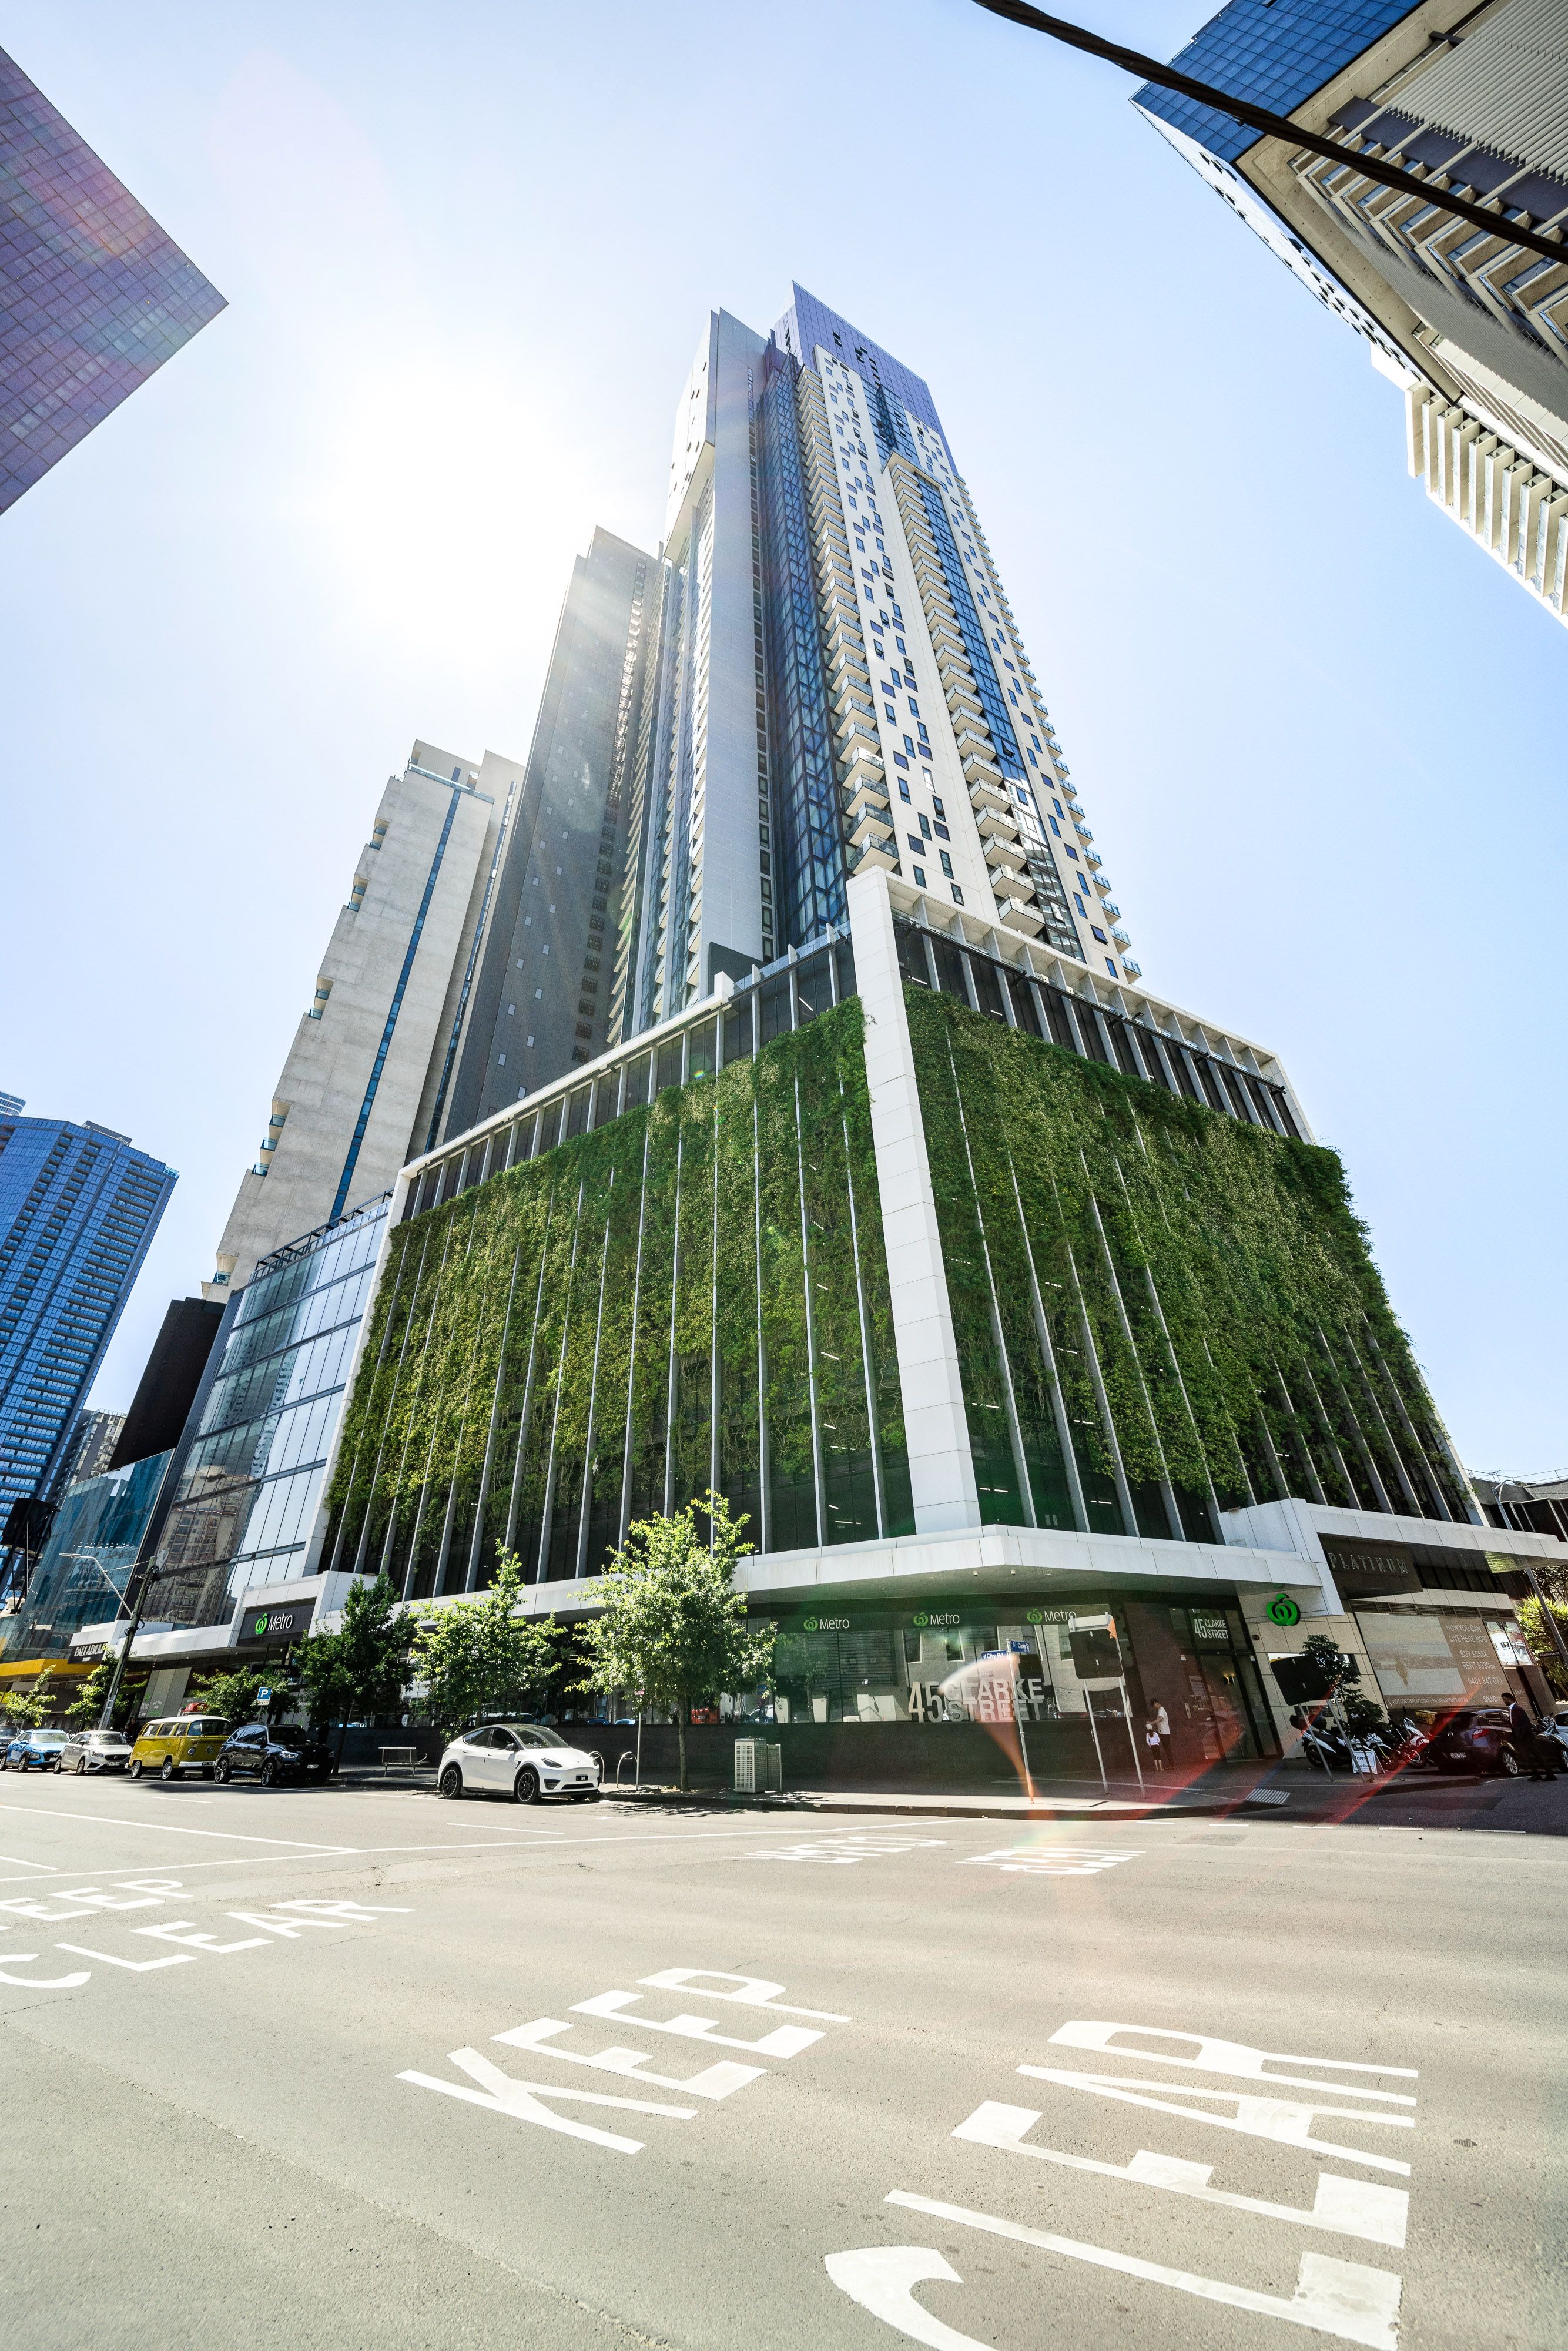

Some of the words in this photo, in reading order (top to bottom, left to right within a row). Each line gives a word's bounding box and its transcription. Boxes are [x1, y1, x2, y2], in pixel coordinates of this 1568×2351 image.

[1328, 1553, 1408, 1574] PLATINUM
[267, 1613, 293, 1631] Metro
[820, 1617, 850, 1630] Metro
[930, 1613, 960, 1625] Metro
[1044, 1609, 1076, 1622] Metro
[1194, 1619, 1207, 1639] 45
[1204, 1619, 1227, 1628] CLARKE
[1207, 1629, 1229, 1639] STREET
[74, 1643, 105, 1657] PALLADIUM
[1468, 1677, 1482, 1685] 0401
[1482, 1677, 1492, 1685] 347
[260, 1689, 269, 1698] P
[908, 1681, 943, 1723] 45
[944, 1678, 1045, 1701] CLARKE
[948, 1699, 1043, 1722] STREET
[0, 1878, 193, 1931] EEP
[0, 1899, 416, 1988] CLEAR
[394, 1968, 853, 2154] KEEP
